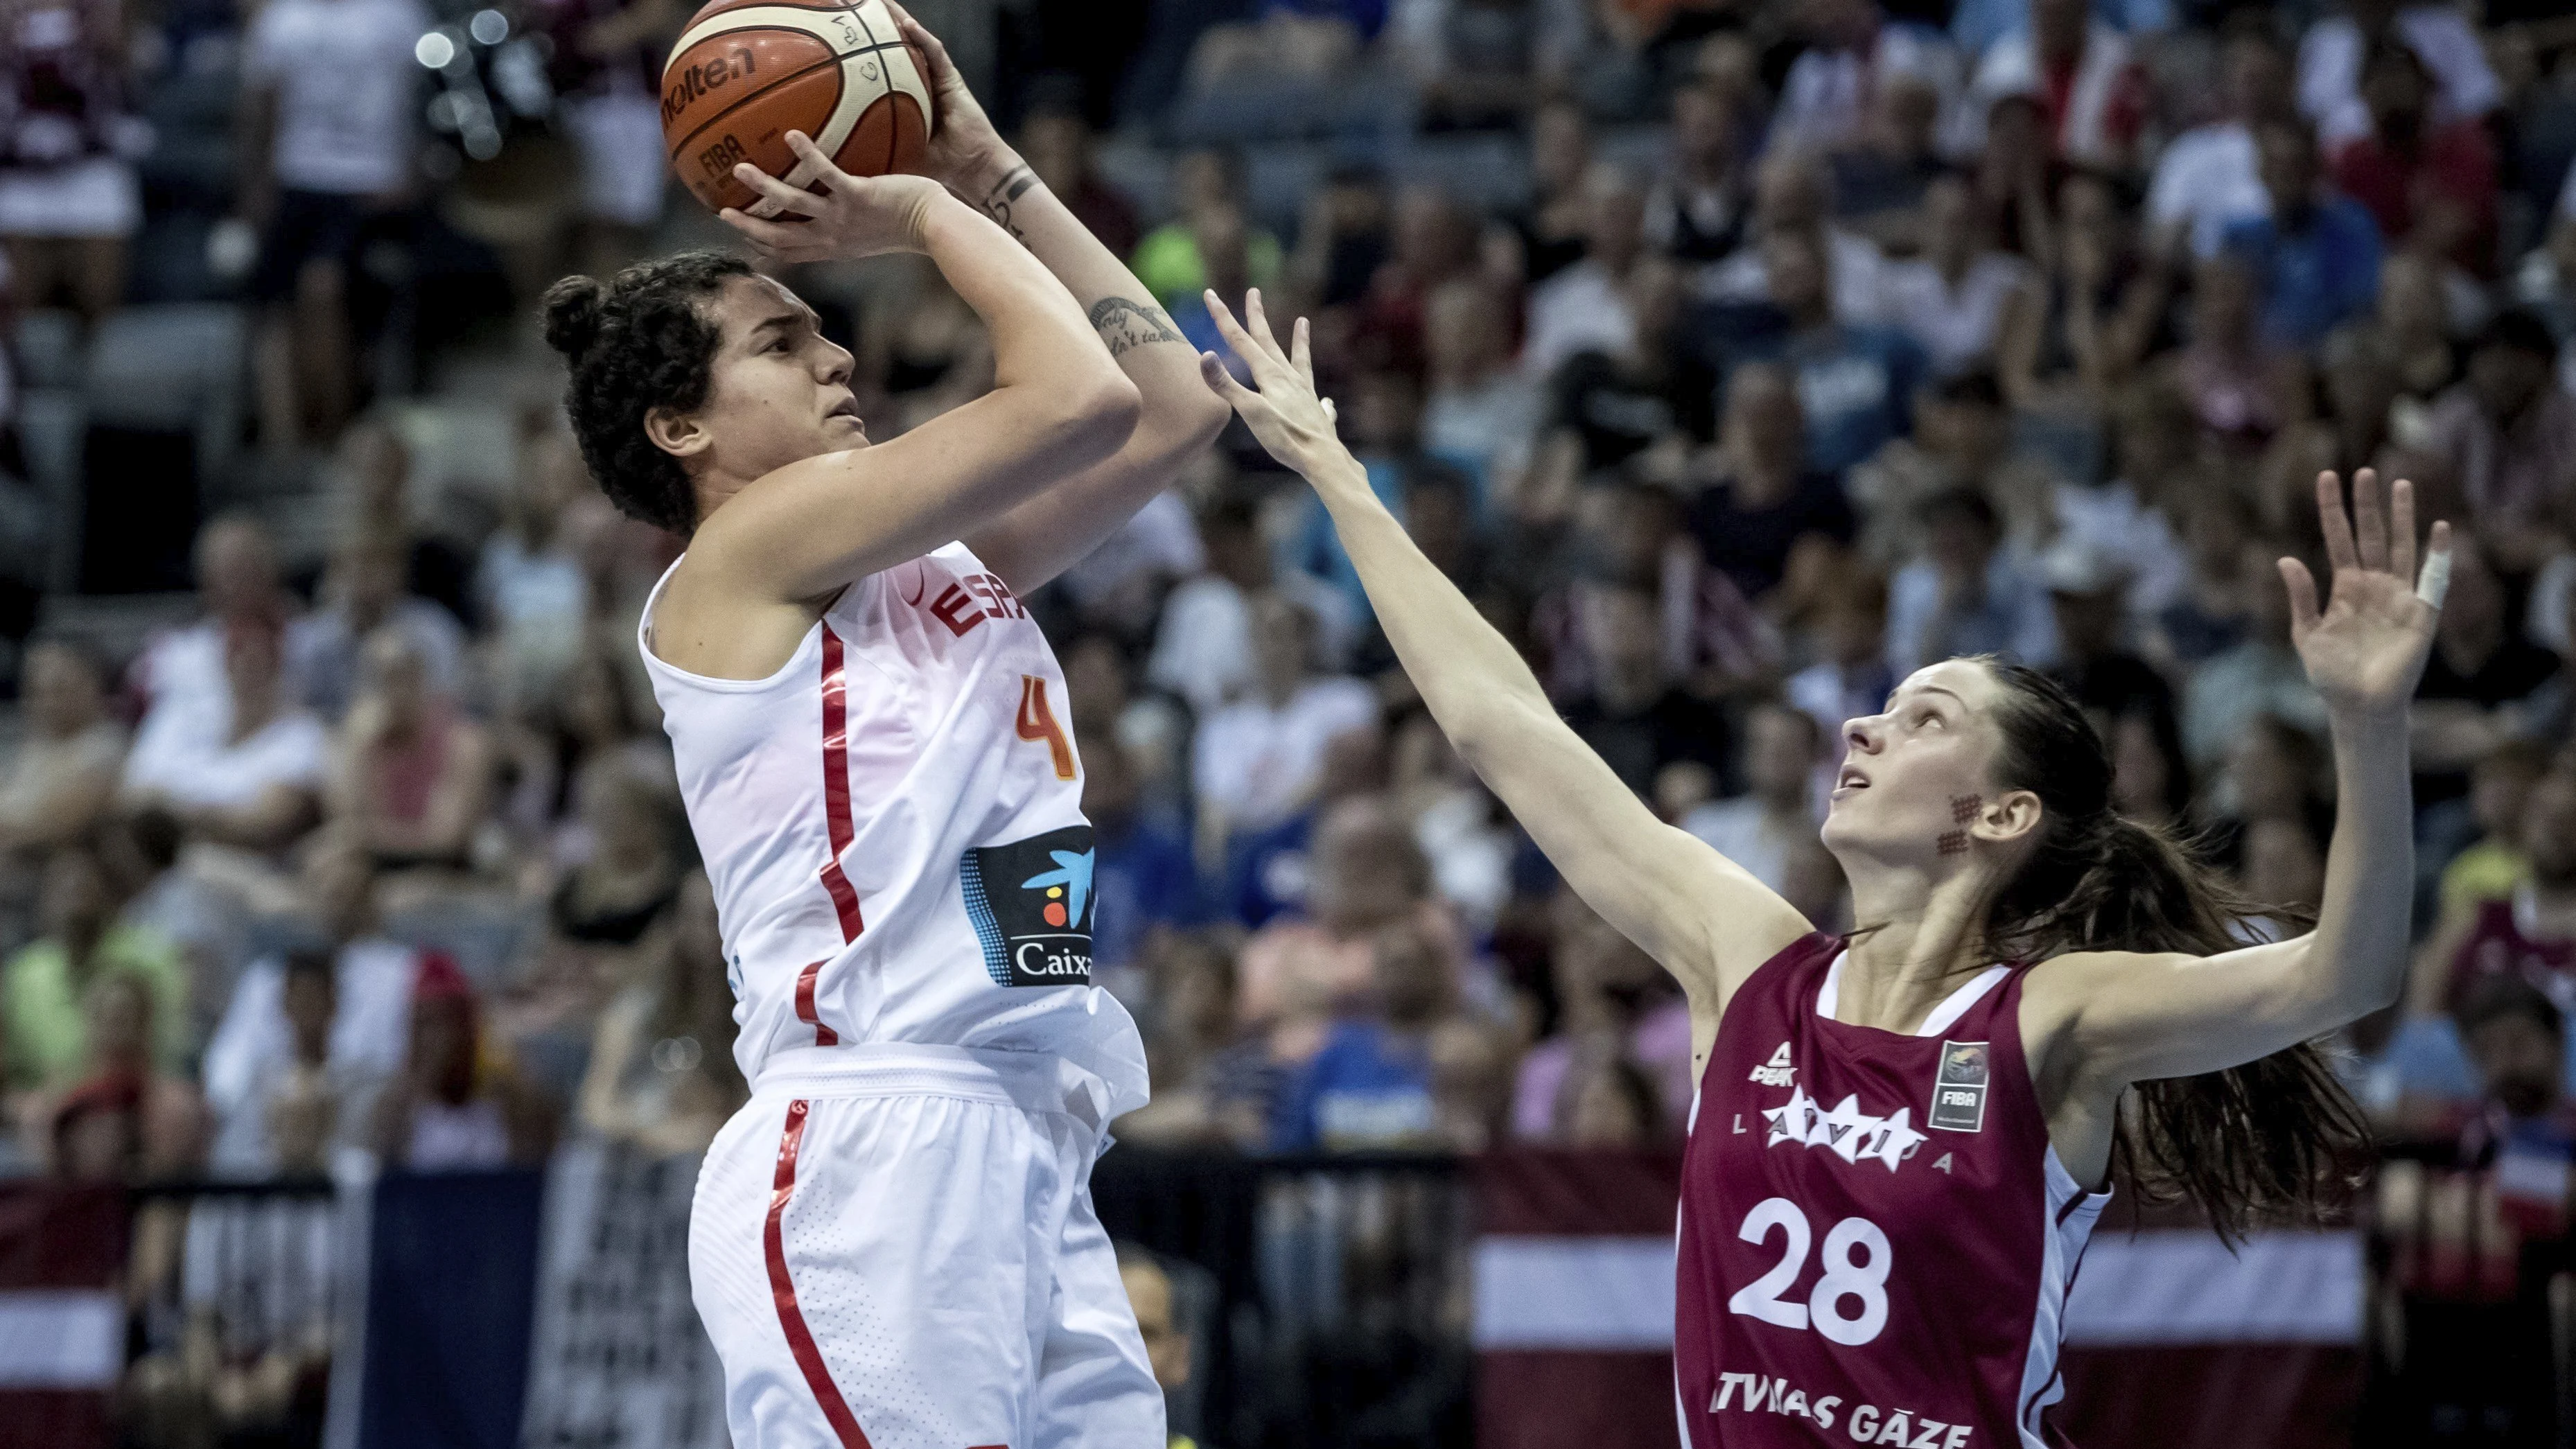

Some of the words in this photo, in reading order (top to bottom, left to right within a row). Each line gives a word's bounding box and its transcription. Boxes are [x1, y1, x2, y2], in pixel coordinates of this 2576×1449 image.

[698, 133, 746, 178] FIBA
[1016, 674, 1076, 781] 4
[1749, 1065, 1798, 1087] PEAK
[1941, 1091, 1977, 1107] FIBA
[1728, 1197, 1893, 1346] 28
